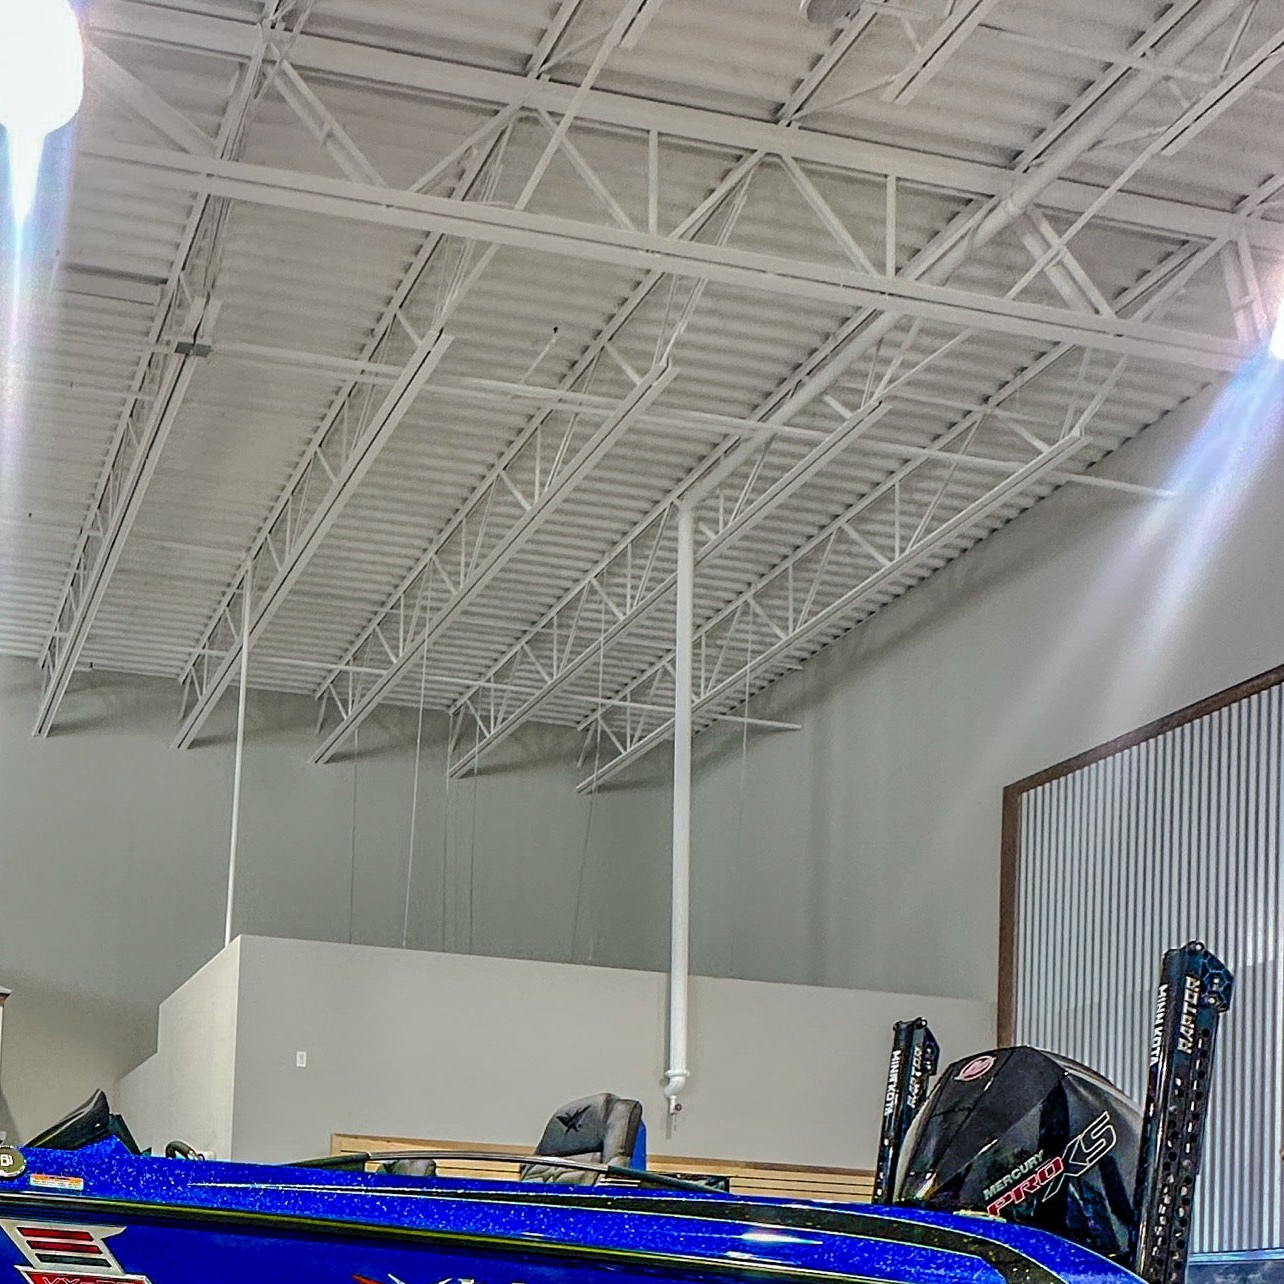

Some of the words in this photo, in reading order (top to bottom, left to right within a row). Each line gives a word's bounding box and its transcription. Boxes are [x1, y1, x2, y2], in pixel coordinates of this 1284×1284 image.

[1156, 984, 1168, 1024] MINN
[1178, 976, 1200, 1054] RAPTOR
[1150, 1026, 1163, 1065] KOTA
[884, 1084, 898, 1116] KOTA
[983, 1149, 1044, 1200] MERCURY
